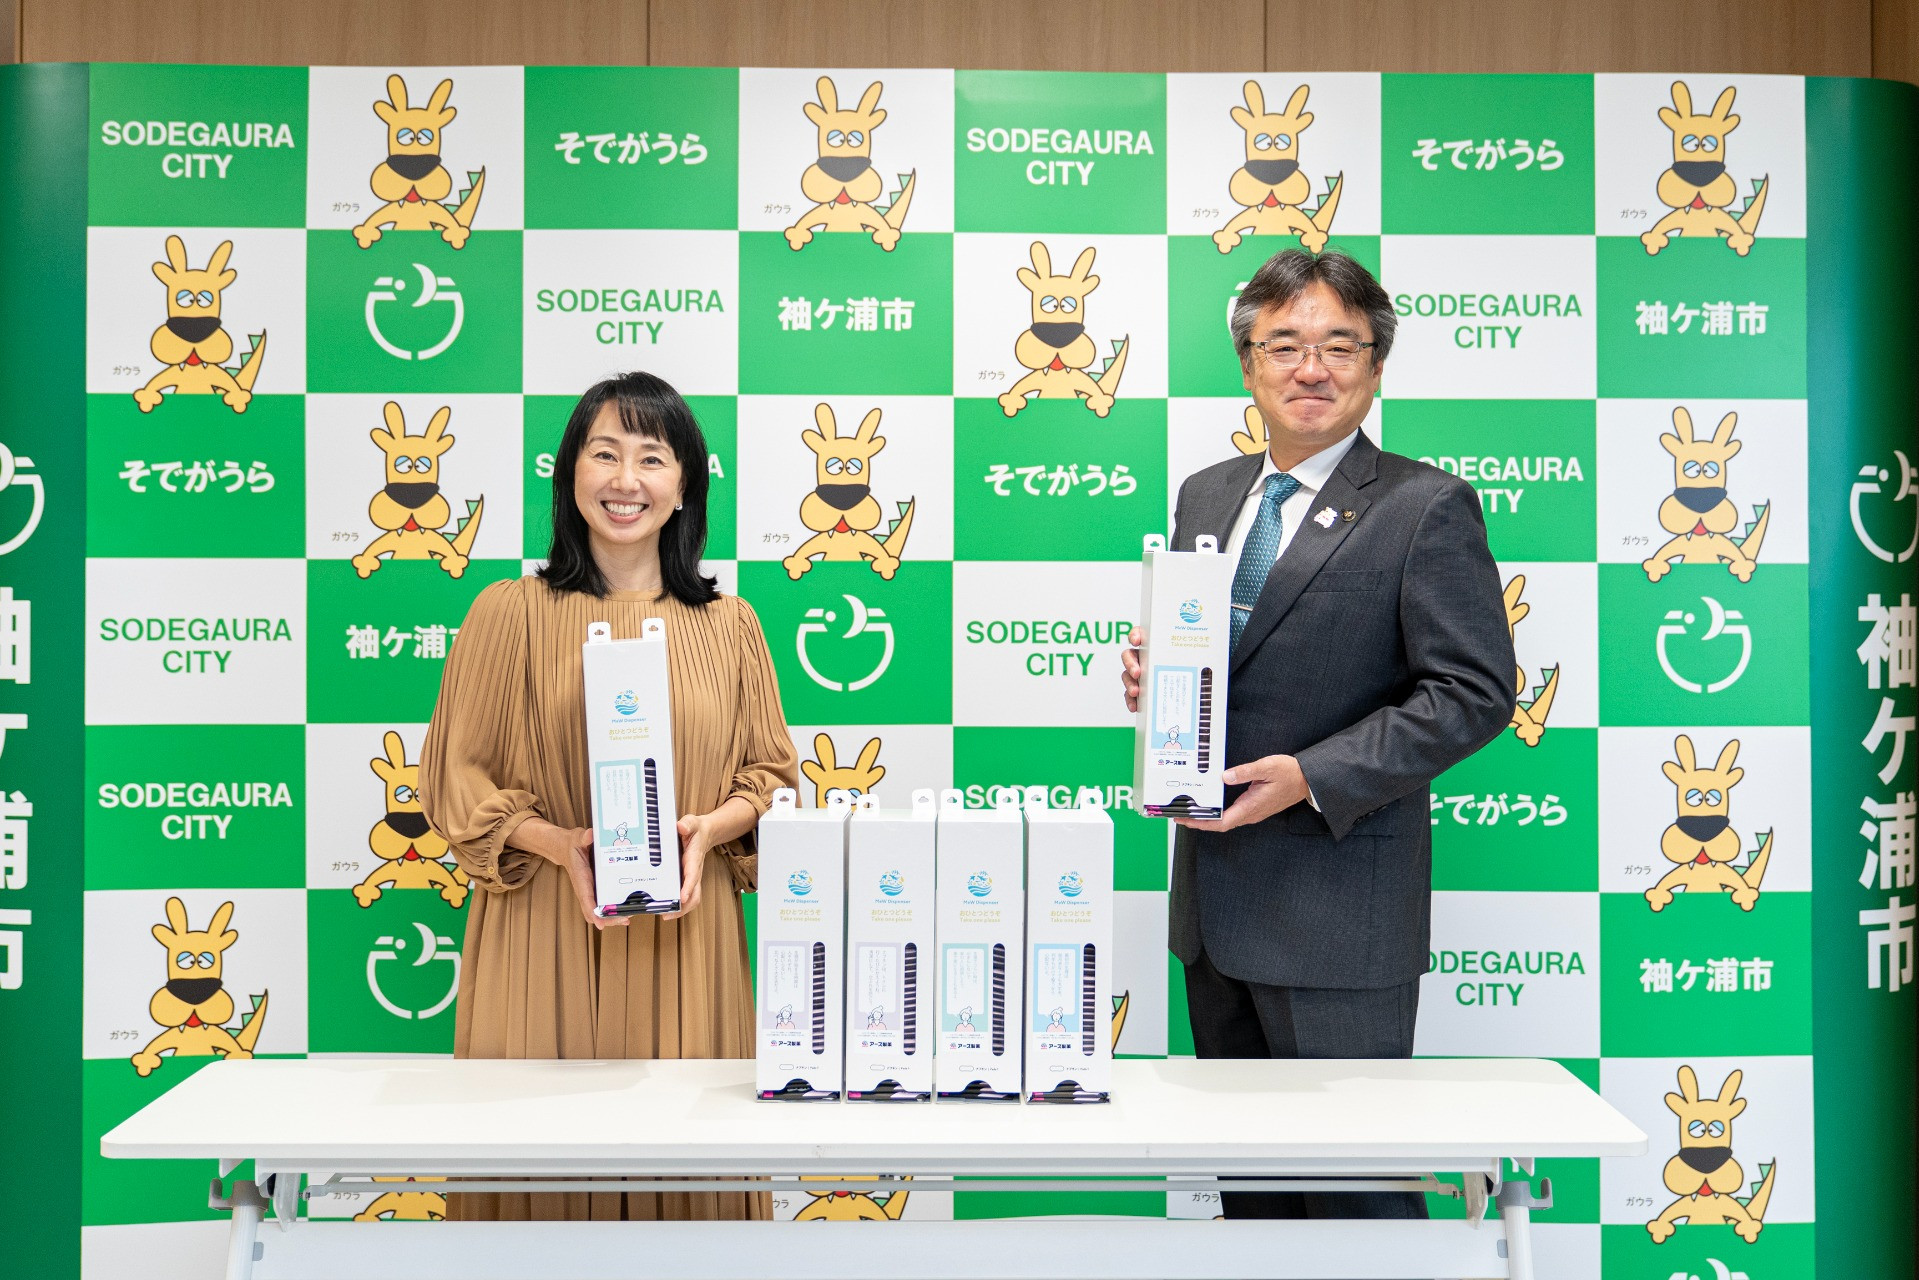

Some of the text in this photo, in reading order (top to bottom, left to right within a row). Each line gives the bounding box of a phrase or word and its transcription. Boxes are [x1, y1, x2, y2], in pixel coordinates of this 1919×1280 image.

[101, 120, 295, 148] SODEGAURA
[965, 128, 1155, 156] SODEGAURA
[555, 132, 708, 165] そでがうら
[1412, 138, 1564, 171] そでがうら
[162, 153, 233, 178] CITY
[1026, 159, 1095, 187] CITY
[332, 201, 361, 213] ガウラ
[764, 203, 792, 215] ガウラ
[1192, 208, 1220, 218] ガウラ
[1620, 208, 1648, 220] ガウラ
[536, 288, 724, 313] SODEGAURA
[1394, 293, 1582, 317] SODEGAURA
[777, 296, 915, 332] 袖ケ浦市
[1635, 300, 1769, 336] 袖ケ浦市
[596, 321, 663, 345] CITY
[1454, 325, 1521, 349] CITY
[112, 365, 141, 376] ガウラ
[978, 369, 1006, 381] ガウラ
[119, 460, 274, 493] そでがうら
[984, 464, 1137, 496] そでがうら
[1417, 456, 1584, 482] DEGAURA
[332, 531, 360, 542] ガウラ
[762, 532, 790, 544] ガウラ
[1622, 535, 1650, 546] ガウラ
[100, 617, 292, 642] SODEGAURA
[966, 620, 1133, 645] SODEGAUR
[162, 649, 232, 674] CITY
[1026, 652, 1094, 677] CITY
[99, 783, 292, 808] SODEGAURA
[162, 815, 232, 840] CITY
[331, 861, 360, 872] ガウラ
[1624, 864, 1652, 876] ガウラ
[1430, 950, 1585, 975] DEGAURA
[1640, 957, 1773, 992] 袖ケ浦市
[1455, 981, 1524, 1007] CITY
[109, 1029, 139, 1041] ガウラ
[772, 1198, 789, 1208] ウラ
[1191, 1192, 1220, 1203] ガウラ
[1626, 1196, 1654, 1207] ガウラ
